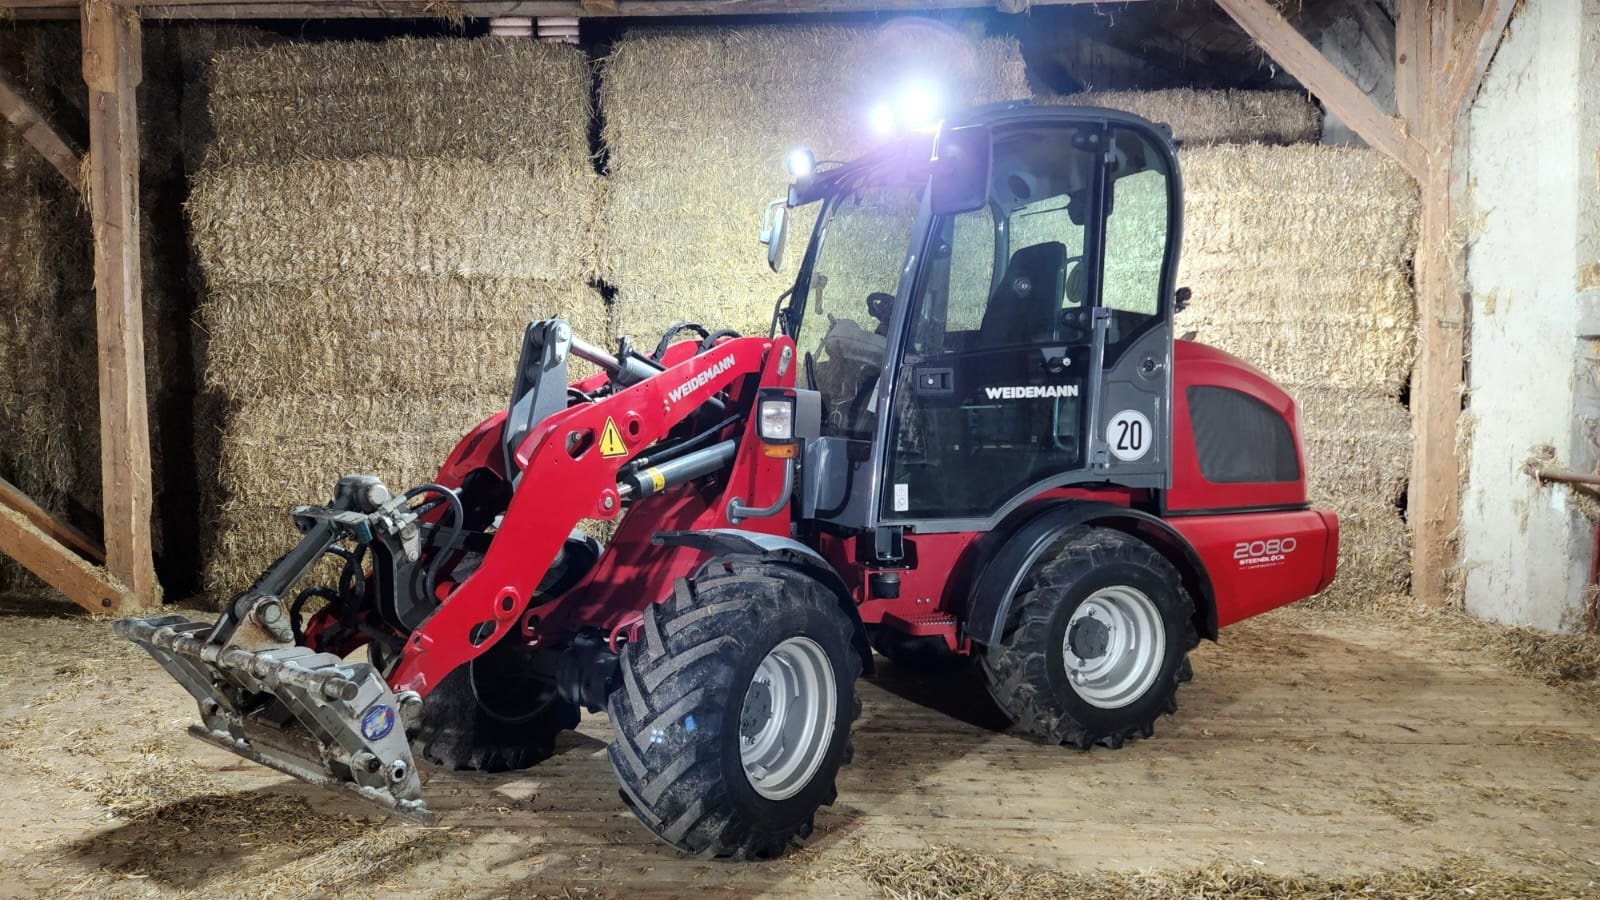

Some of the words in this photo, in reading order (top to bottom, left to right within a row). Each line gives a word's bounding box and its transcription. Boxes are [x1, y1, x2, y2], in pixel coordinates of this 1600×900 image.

[668, 354, 736, 403] WEIDEMANN
[985, 385, 1079, 400] WEIDEMANN
[1117, 420, 1142, 450] 20
[1233, 537, 1297, 559] 2080
